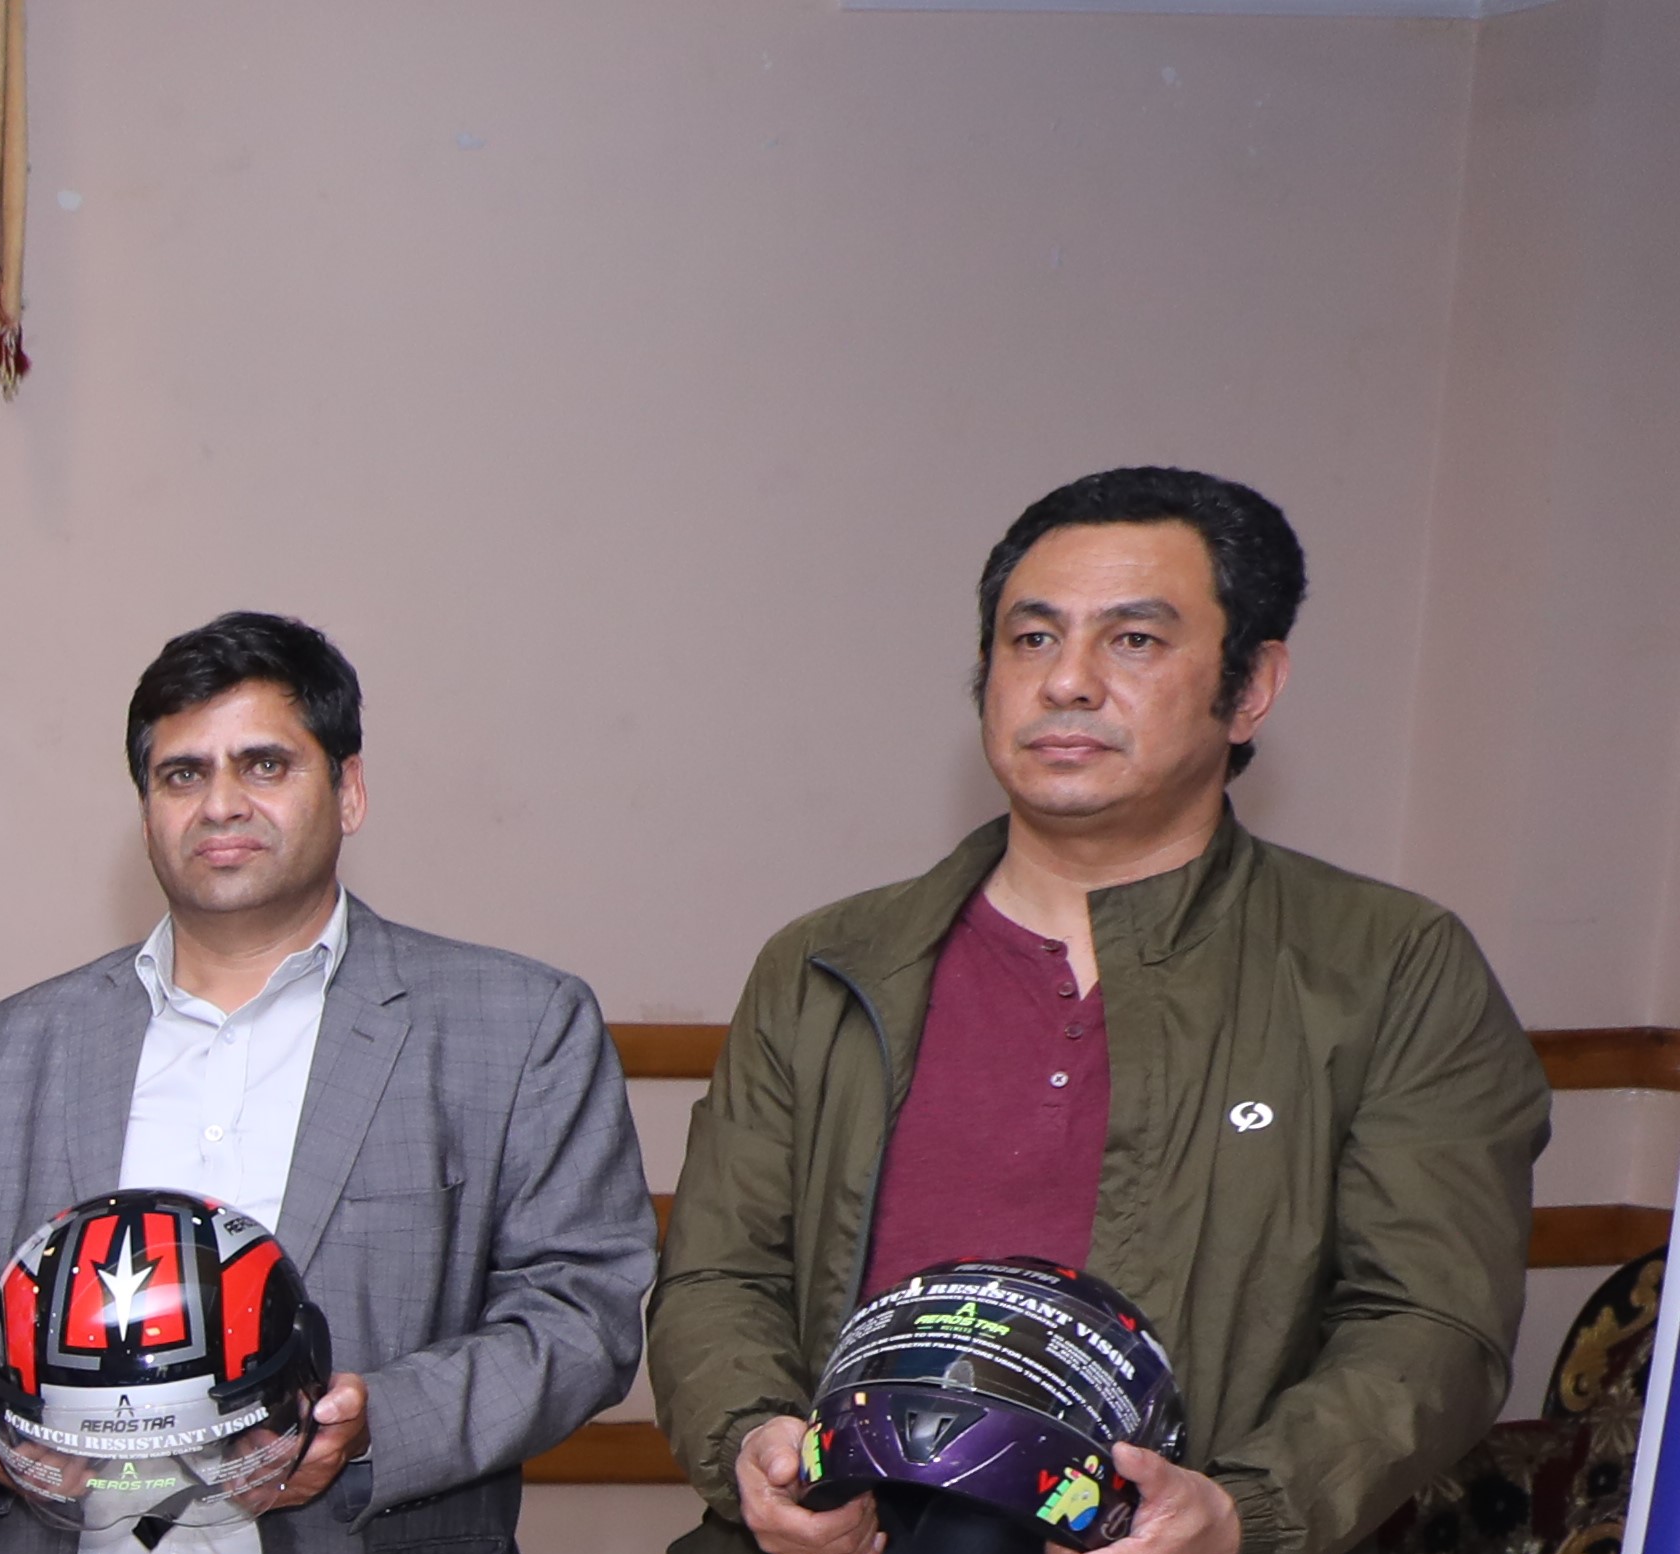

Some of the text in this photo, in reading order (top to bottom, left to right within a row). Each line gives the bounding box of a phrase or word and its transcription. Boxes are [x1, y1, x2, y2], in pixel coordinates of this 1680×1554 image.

[954, 1263, 1061, 1285] AEROSTAR
[914, 1314, 1011, 1335] AEROSTAR
[929, 1283, 1074, 1325] RESISTANT
[1076, 1321, 1137, 1381] VISOR
[4, 1406, 270, 1451] SCRATCH RESISTANT VISOR
[80, 1415, 176, 1433] AEROSTAR
[86, 1477, 177, 1490] AEROSTAR
